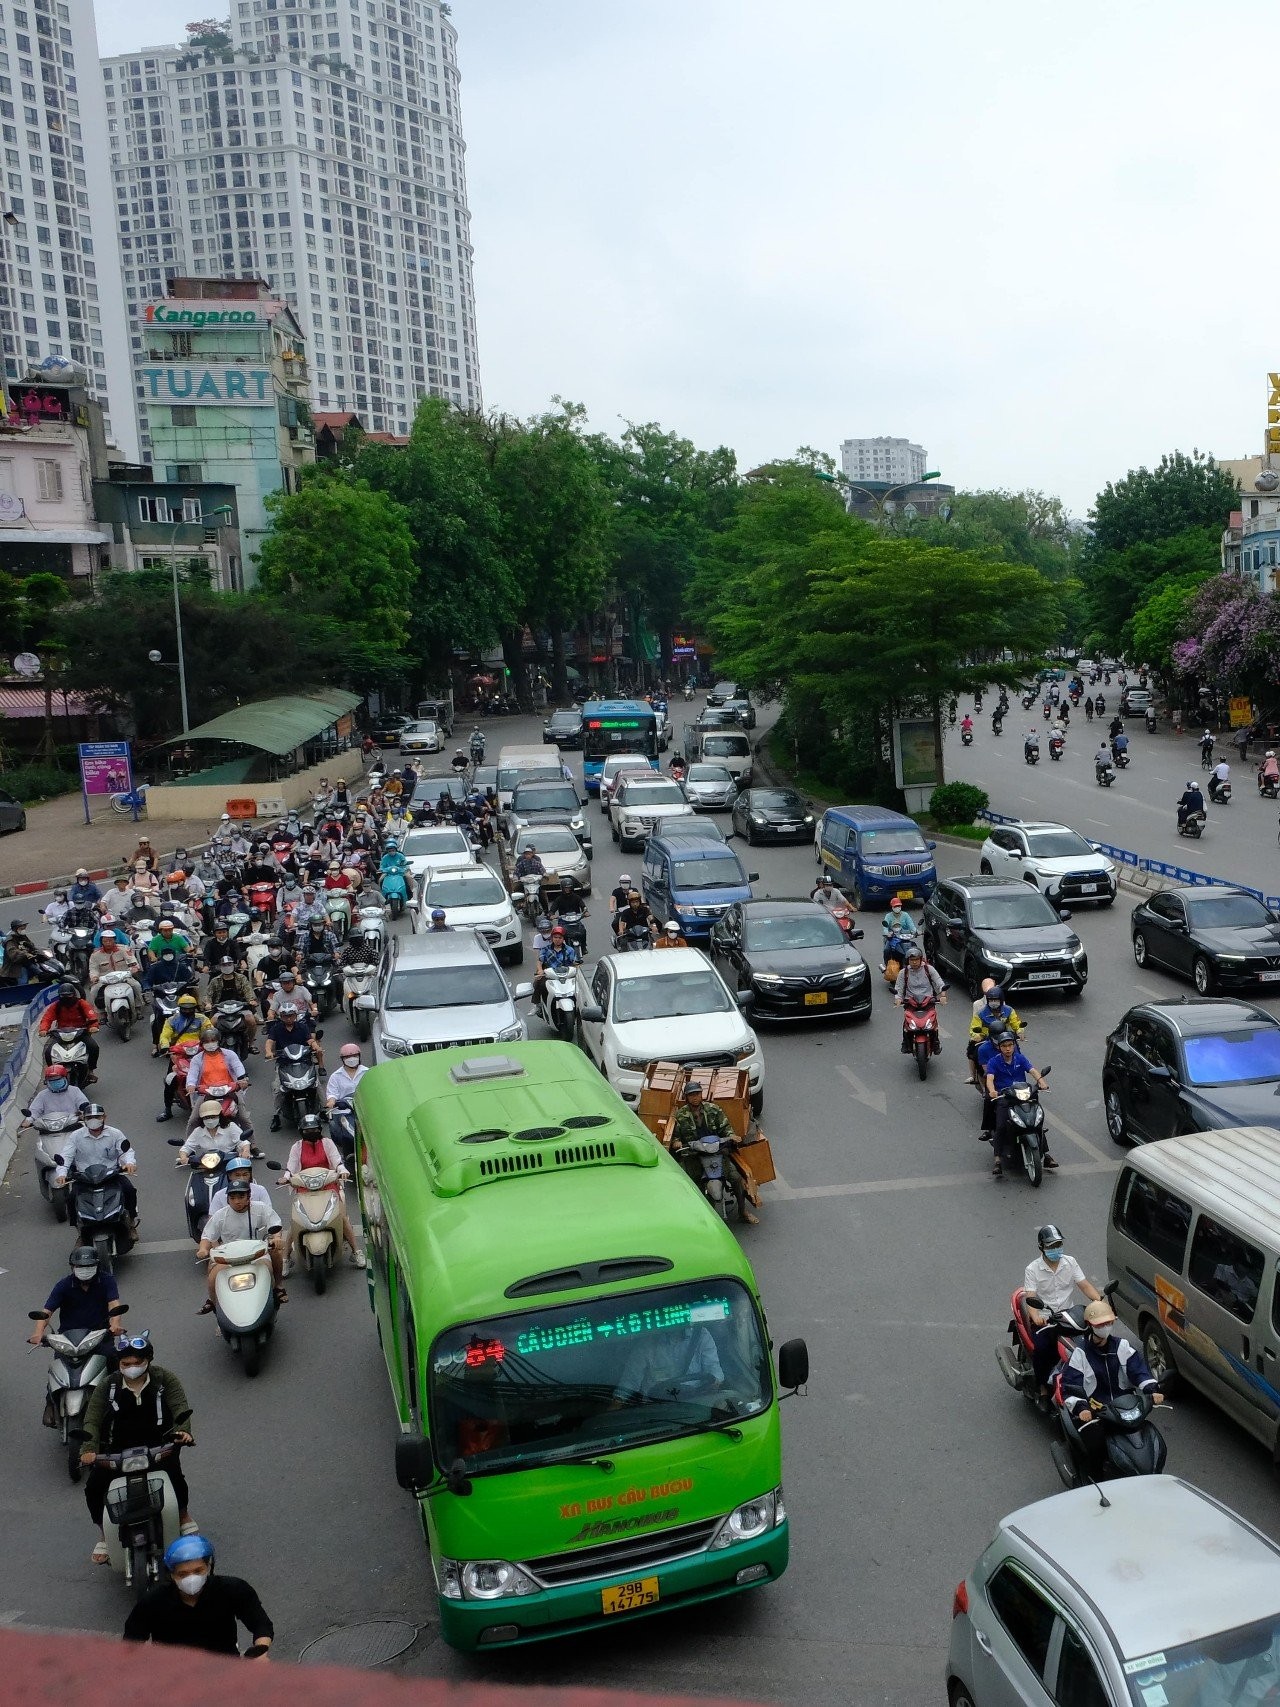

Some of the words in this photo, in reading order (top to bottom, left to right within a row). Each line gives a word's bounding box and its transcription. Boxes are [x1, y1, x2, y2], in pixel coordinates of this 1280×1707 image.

[143, 369, 270, 400] TUART
[586, 1495, 613, 1514] BUS
[618, 1581, 643, 1598] 29B
[610, 1591, 654, 1612] 147.75
